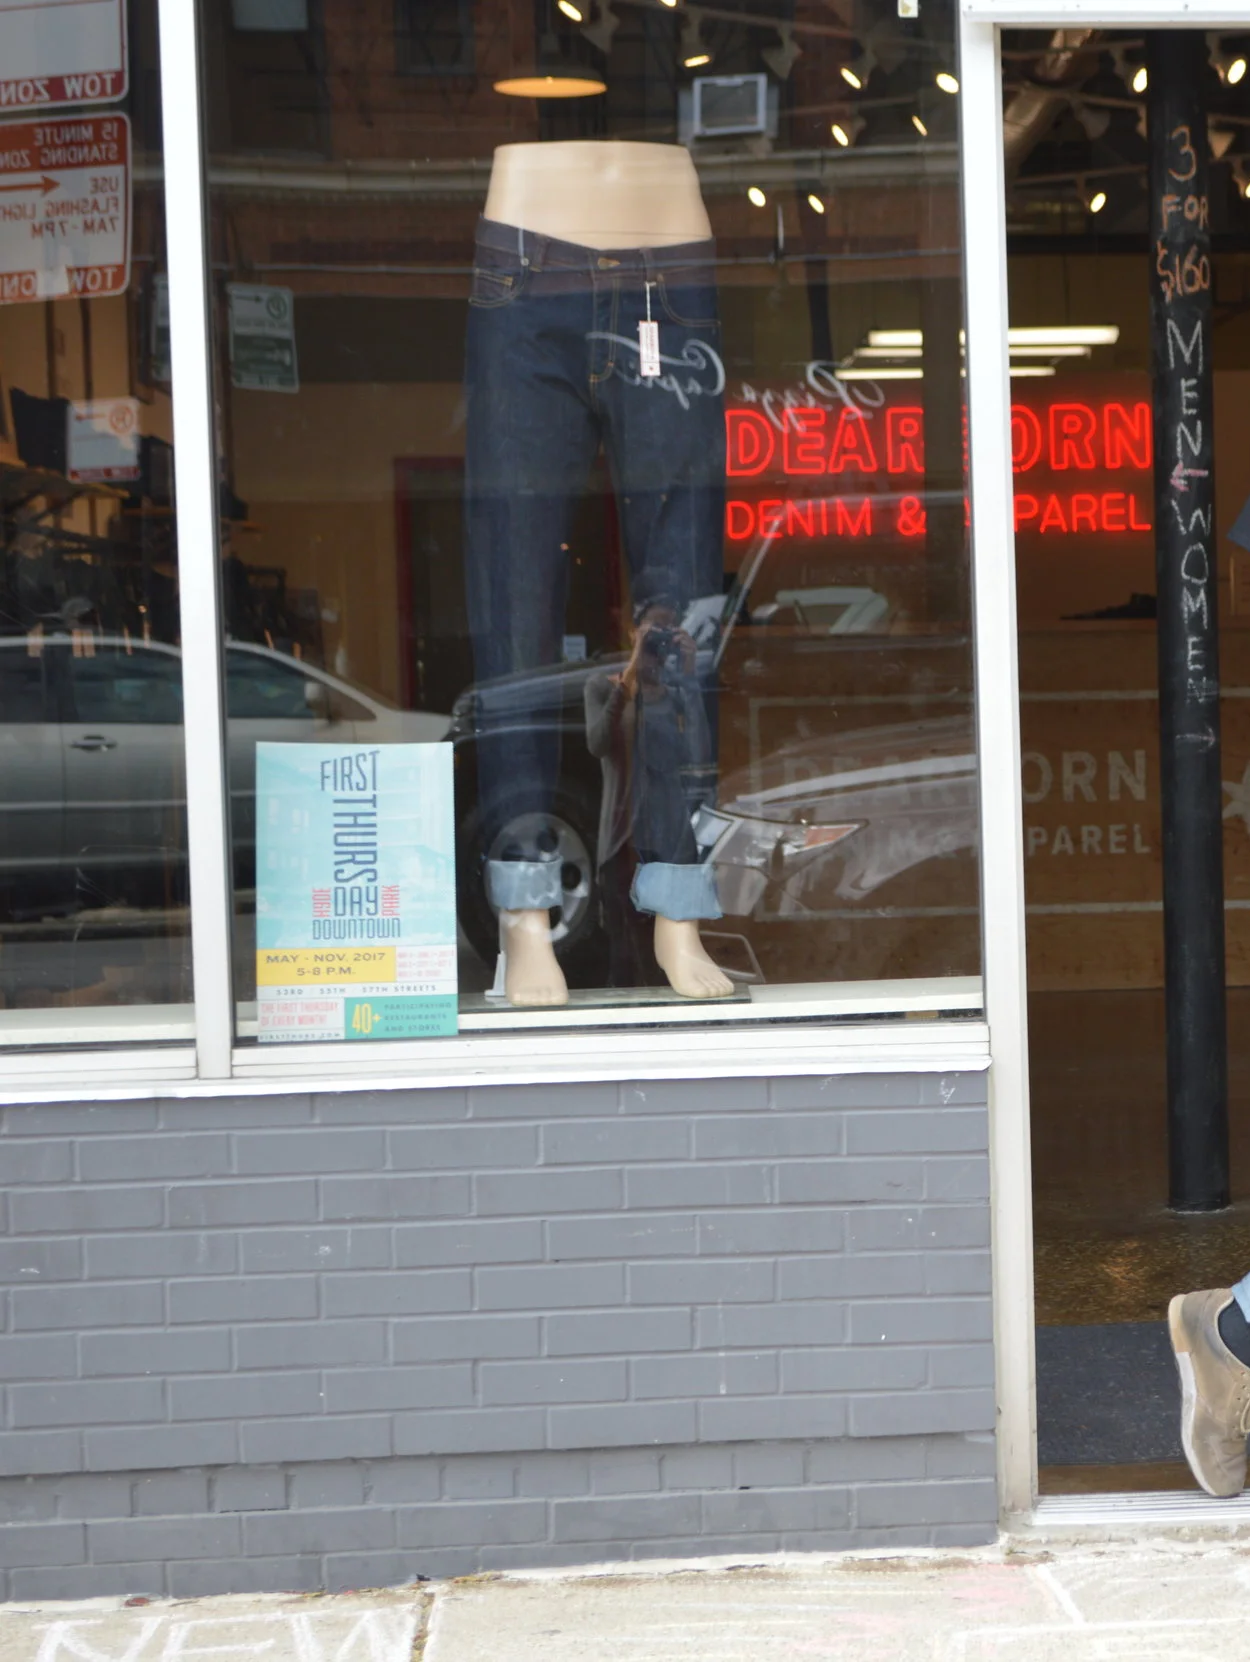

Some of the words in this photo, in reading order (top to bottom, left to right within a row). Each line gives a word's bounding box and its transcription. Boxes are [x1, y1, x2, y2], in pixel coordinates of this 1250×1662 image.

[1168, 124, 1197, 182] 3
[1162, 194, 1209, 232] FOR
[1157, 240, 1211, 305] $160
[1166, 318, 1204, 461] MEN
[725, 402, 1151, 477] DEARORN
[726, 496, 872, 541] DENIM
[897, 495, 927, 537] &
[962, 492, 1152, 534] PAREL
[1170, 498, 1212, 704] WOMEN
[320, 749, 381, 792] FIRST
[332, 794, 379, 884] THURS
[312, 887, 332, 918] HYDE
[334, 885, 379, 917] DAY
[381, 884, 400, 917] PARK
[312, 918, 400, 940] DOWNTOWN
[266, 954, 299, 965] MAY
[353, 952, 386, 962] 2017
[297, 967, 321, 977] 5-8
[325, 966, 356, 976] P.M.
[394, 984, 437, 992] STREETS
